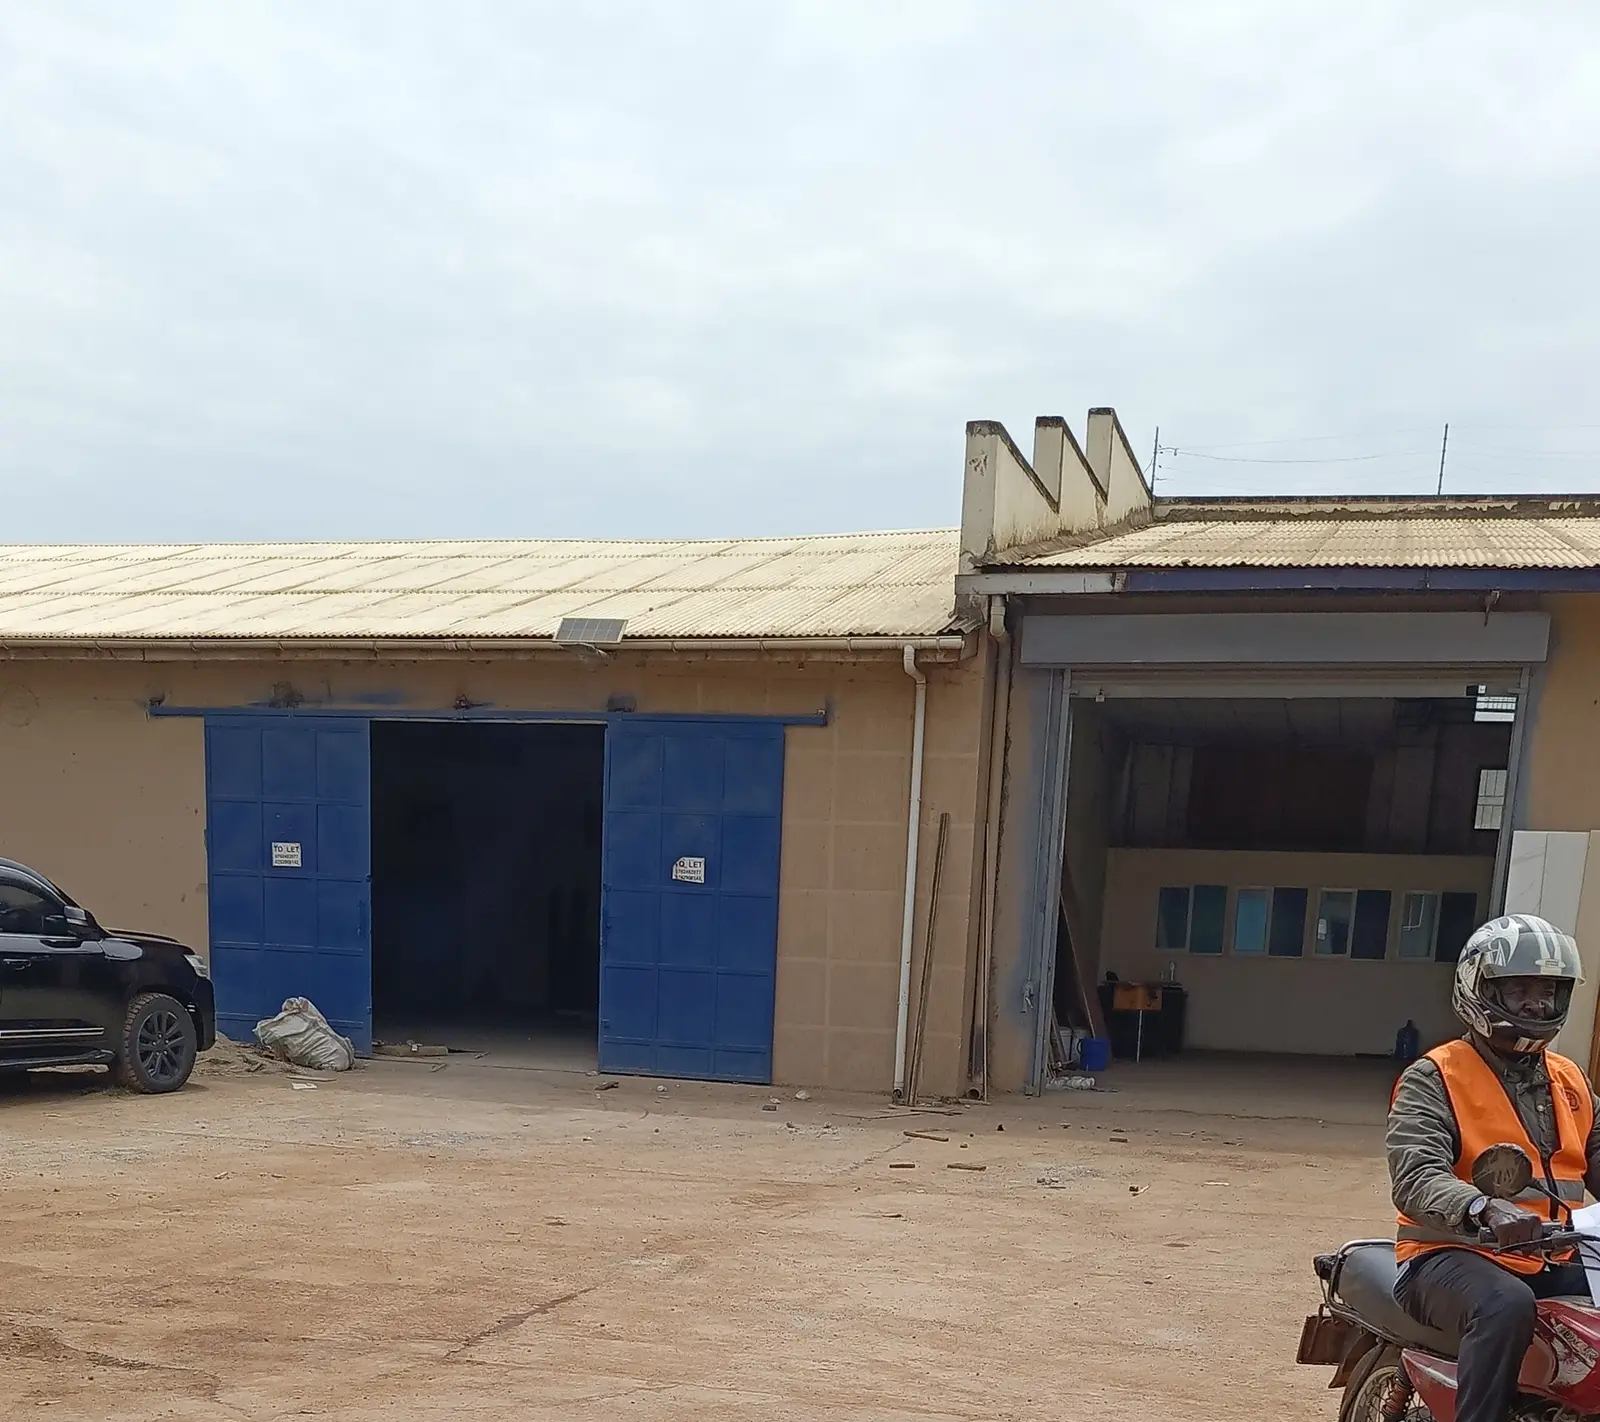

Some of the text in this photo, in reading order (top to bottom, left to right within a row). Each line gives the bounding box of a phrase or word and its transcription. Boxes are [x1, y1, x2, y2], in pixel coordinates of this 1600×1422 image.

[274, 845, 299, 853] TO LET
[689, 860, 702, 868] LET
